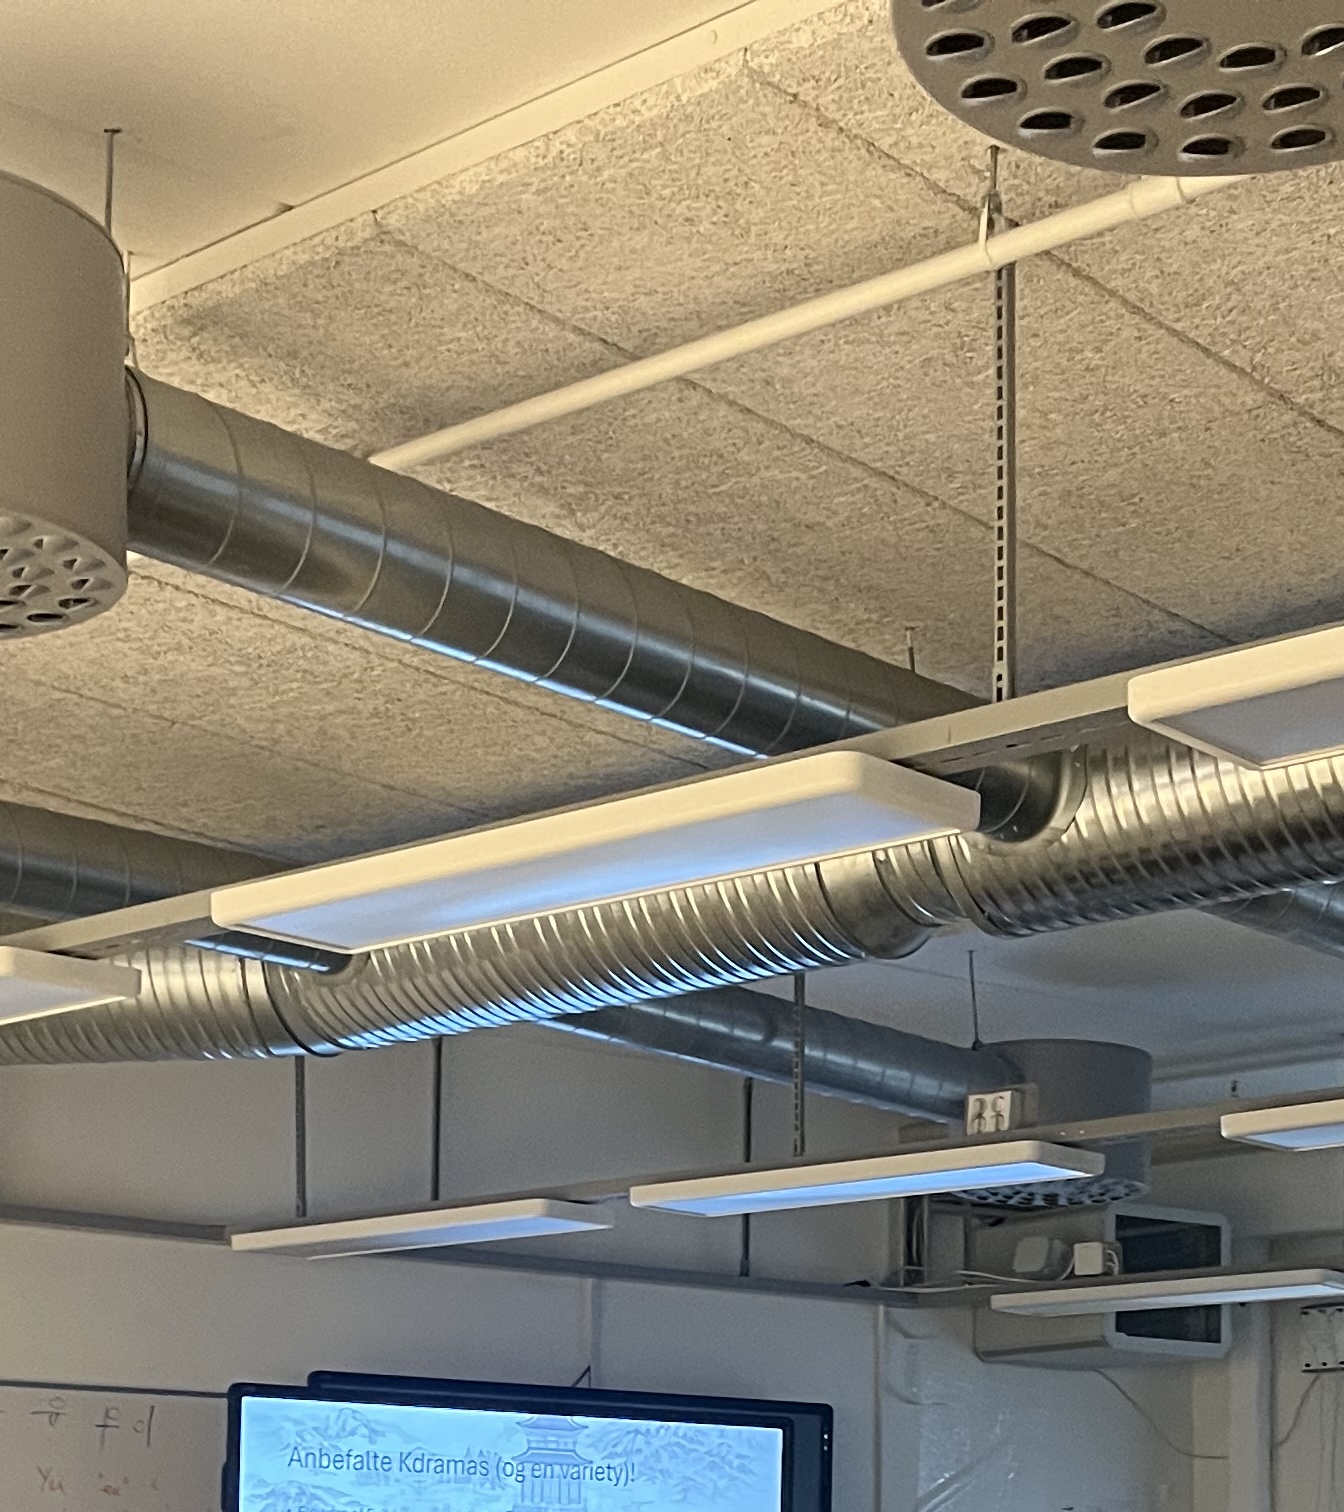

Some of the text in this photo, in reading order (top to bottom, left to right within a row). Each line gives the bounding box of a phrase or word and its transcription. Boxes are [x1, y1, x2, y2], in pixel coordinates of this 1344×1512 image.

[287, 1446, 636, 1487] Anbefalte Kdramas (og en variety)!
